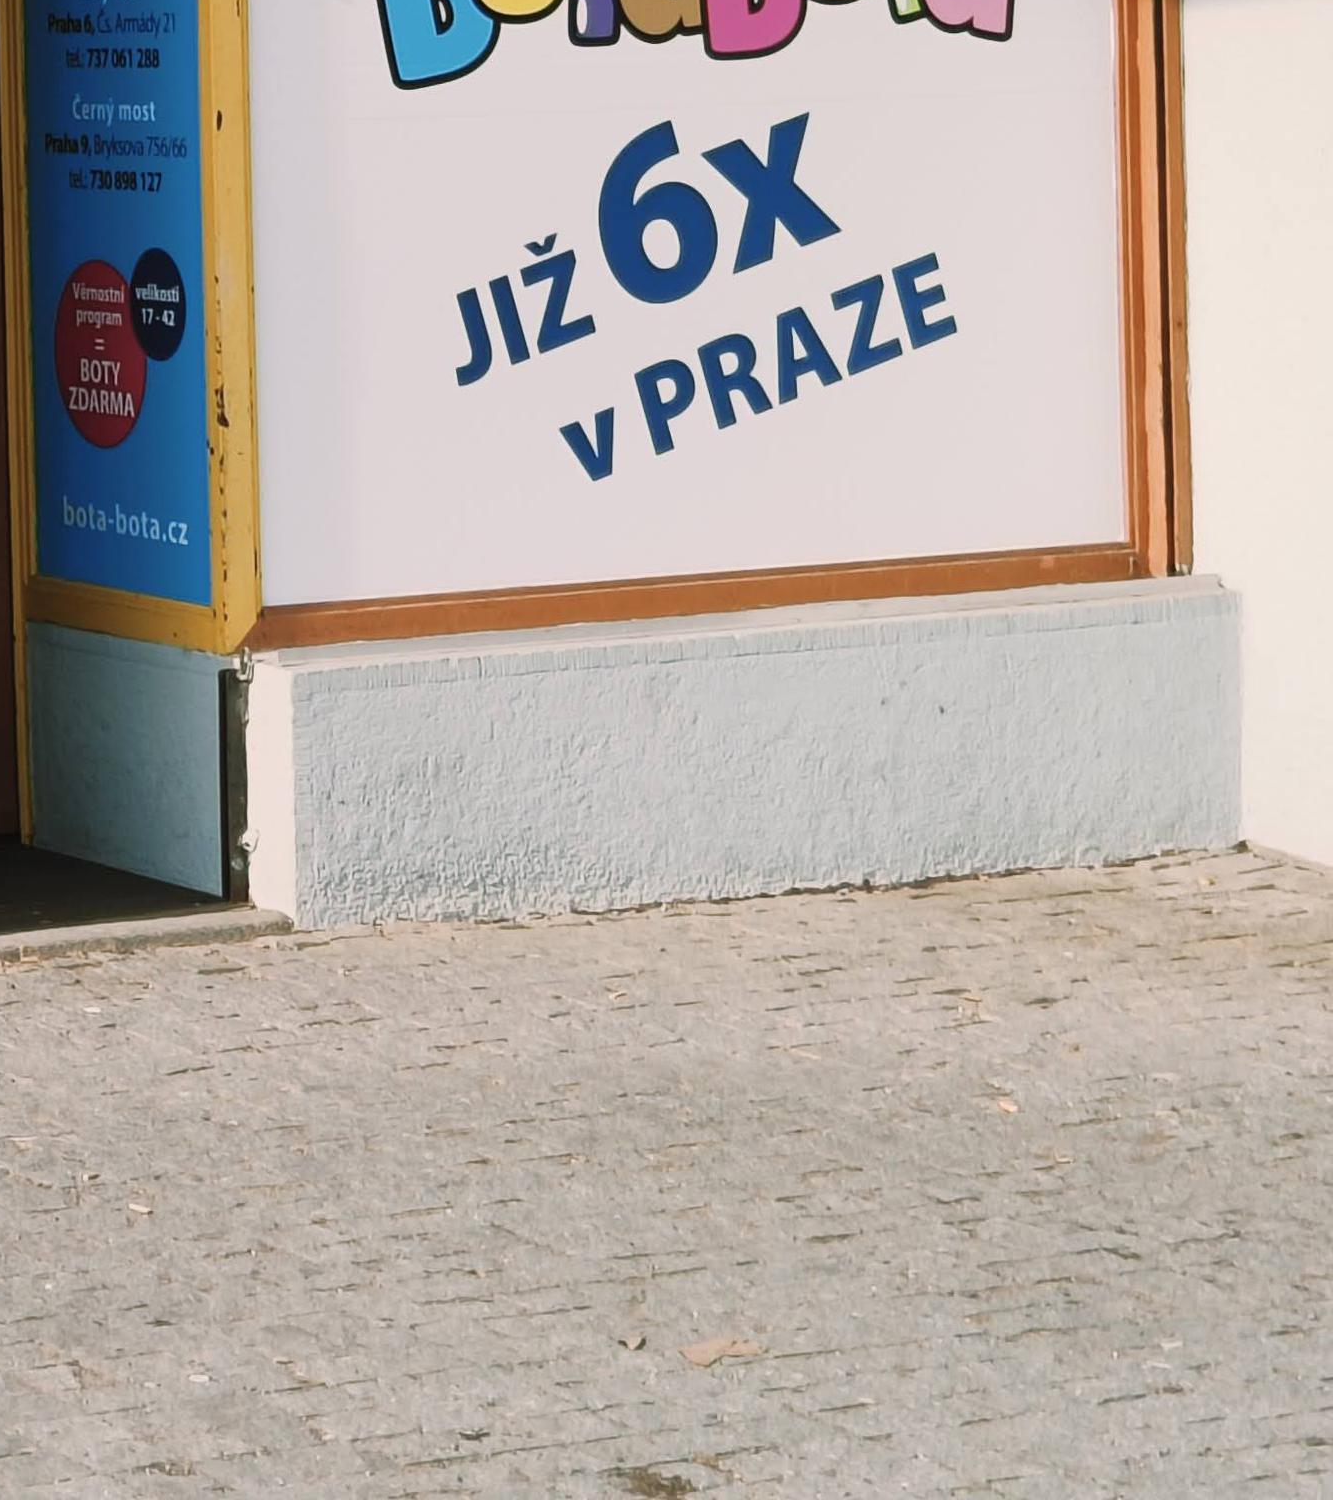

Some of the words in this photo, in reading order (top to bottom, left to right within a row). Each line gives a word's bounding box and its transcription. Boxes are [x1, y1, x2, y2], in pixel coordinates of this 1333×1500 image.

[47, 13, 82, 34] Praha
[115, 12, 162, 38] Armády
[162, 12, 176, 33] 21
[86, 49, 109, 68] 737
[111, 49, 134, 68] 061
[135, 48, 160, 69] 288
[71, 93, 114, 128] Černý
[118, 101, 156, 123] most
[44, 132, 80, 155] Praha
[89, 170, 112, 190] 730
[114, 171, 137, 191] 898
[140, 172, 162, 193] 127
[71, 281, 126, 305] Věrnostní
[134, 282, 180, 304] velikosti
[75, 307, 122, 329] program
[454, 232, 597, 389] JIŽ
[632, 252, 959, 457] PRAZE
[79, 358, 120, 387] BOTY
[68, 386, 135, 419] ZDARMA
[62, 494, 190, 546] bota-bota.cz
